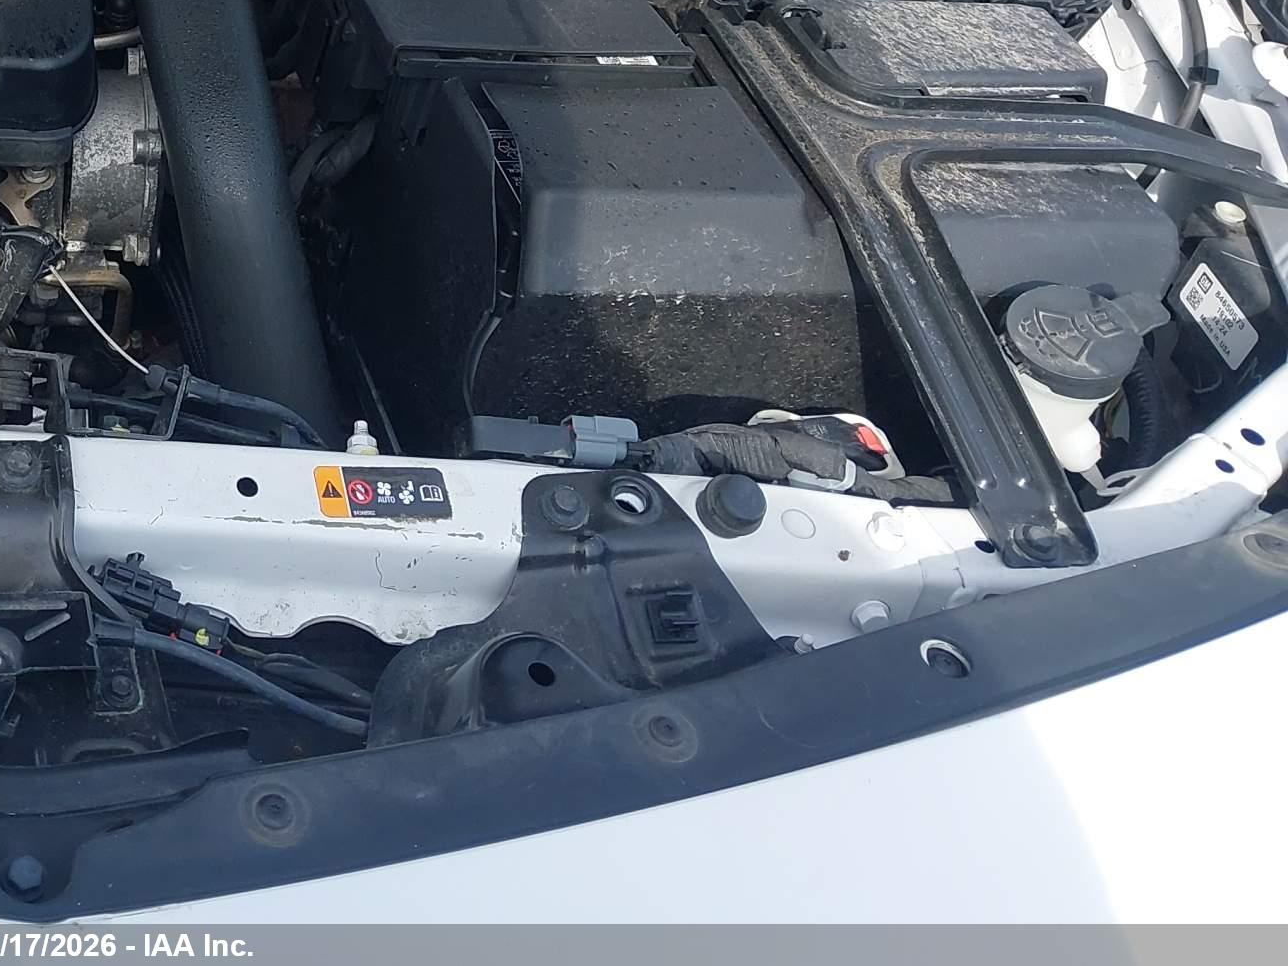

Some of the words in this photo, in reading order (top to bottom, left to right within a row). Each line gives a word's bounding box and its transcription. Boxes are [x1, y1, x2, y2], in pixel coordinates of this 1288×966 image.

[1215, 290, 1246, 331] 84650573
[1219, 340, 1231, 356] USA
[377, 496, 396, 504] AUTO
